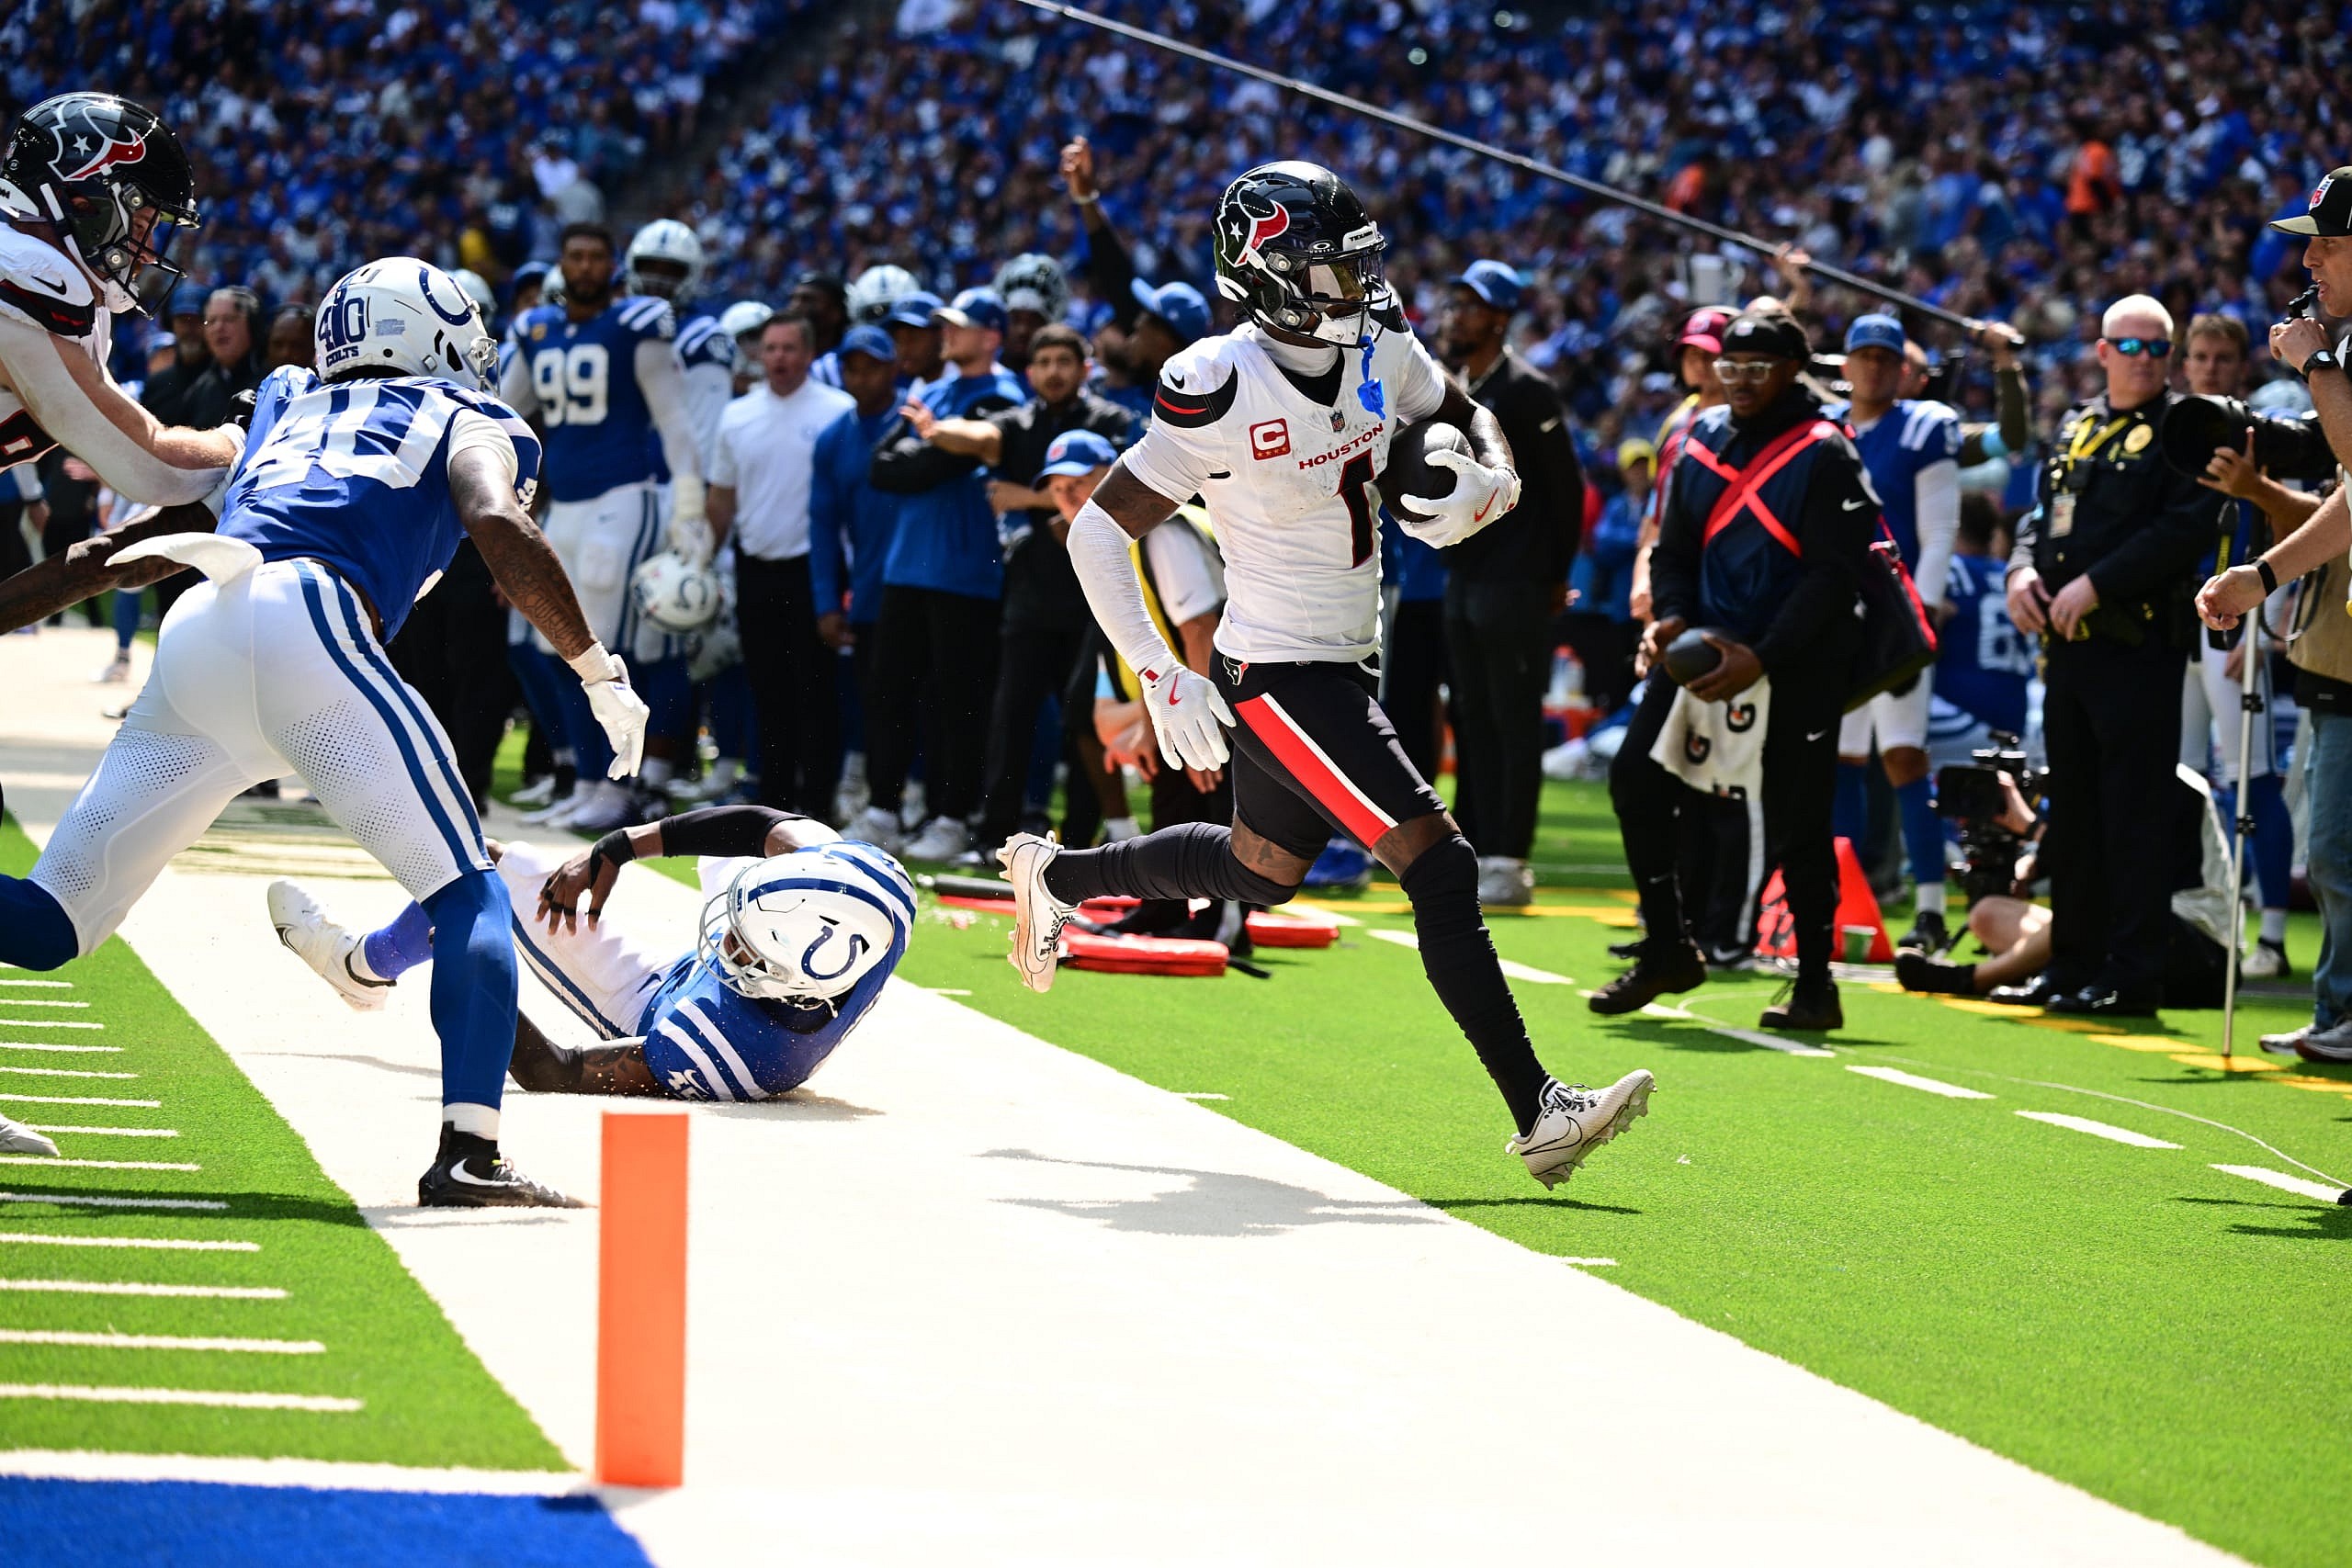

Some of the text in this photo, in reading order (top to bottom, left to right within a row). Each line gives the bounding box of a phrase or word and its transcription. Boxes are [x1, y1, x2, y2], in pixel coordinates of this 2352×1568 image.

[318, 298, 367, 352] 40
[325, 345, 360, 368] COLTS
[533, 343, 610, 427] 99
[1253, 423, 1286, 451] C
[1298, 423, 1385, 470] HOUSTON
[1335, 447, 1375, 569] 1
